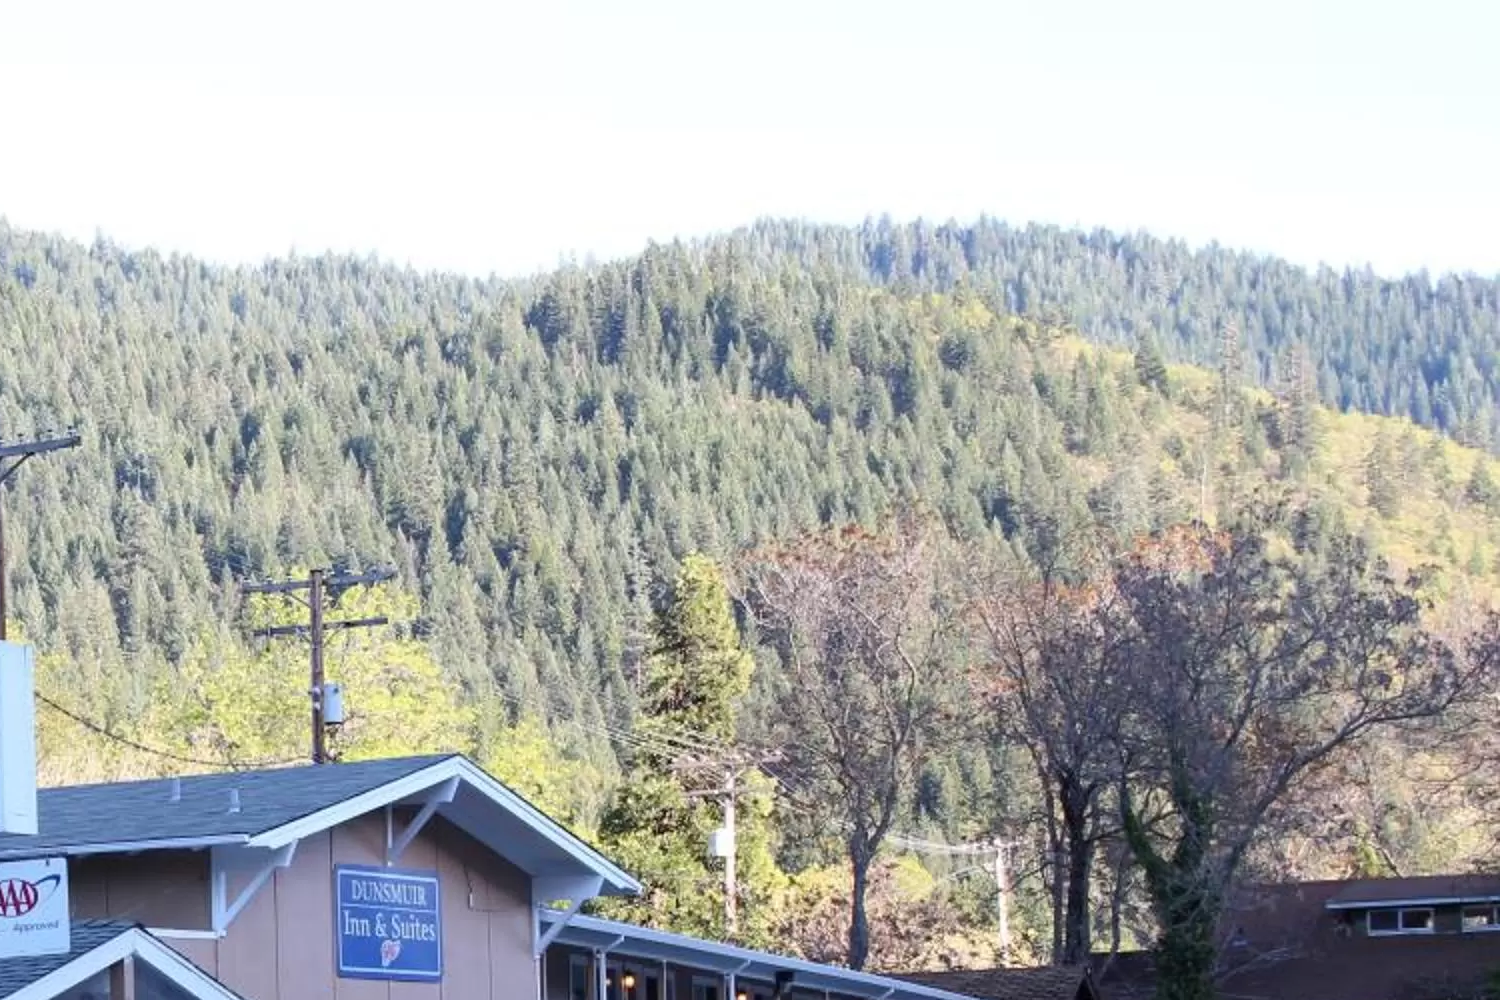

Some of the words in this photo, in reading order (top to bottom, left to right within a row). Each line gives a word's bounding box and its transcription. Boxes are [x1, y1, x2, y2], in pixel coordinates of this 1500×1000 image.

[351, 879, 427, 906] DUNSMUIR
[343, 910, 371, 936] Inn
[375, 912, 388, 937] &
[391, 914, 435, 941] Suites
